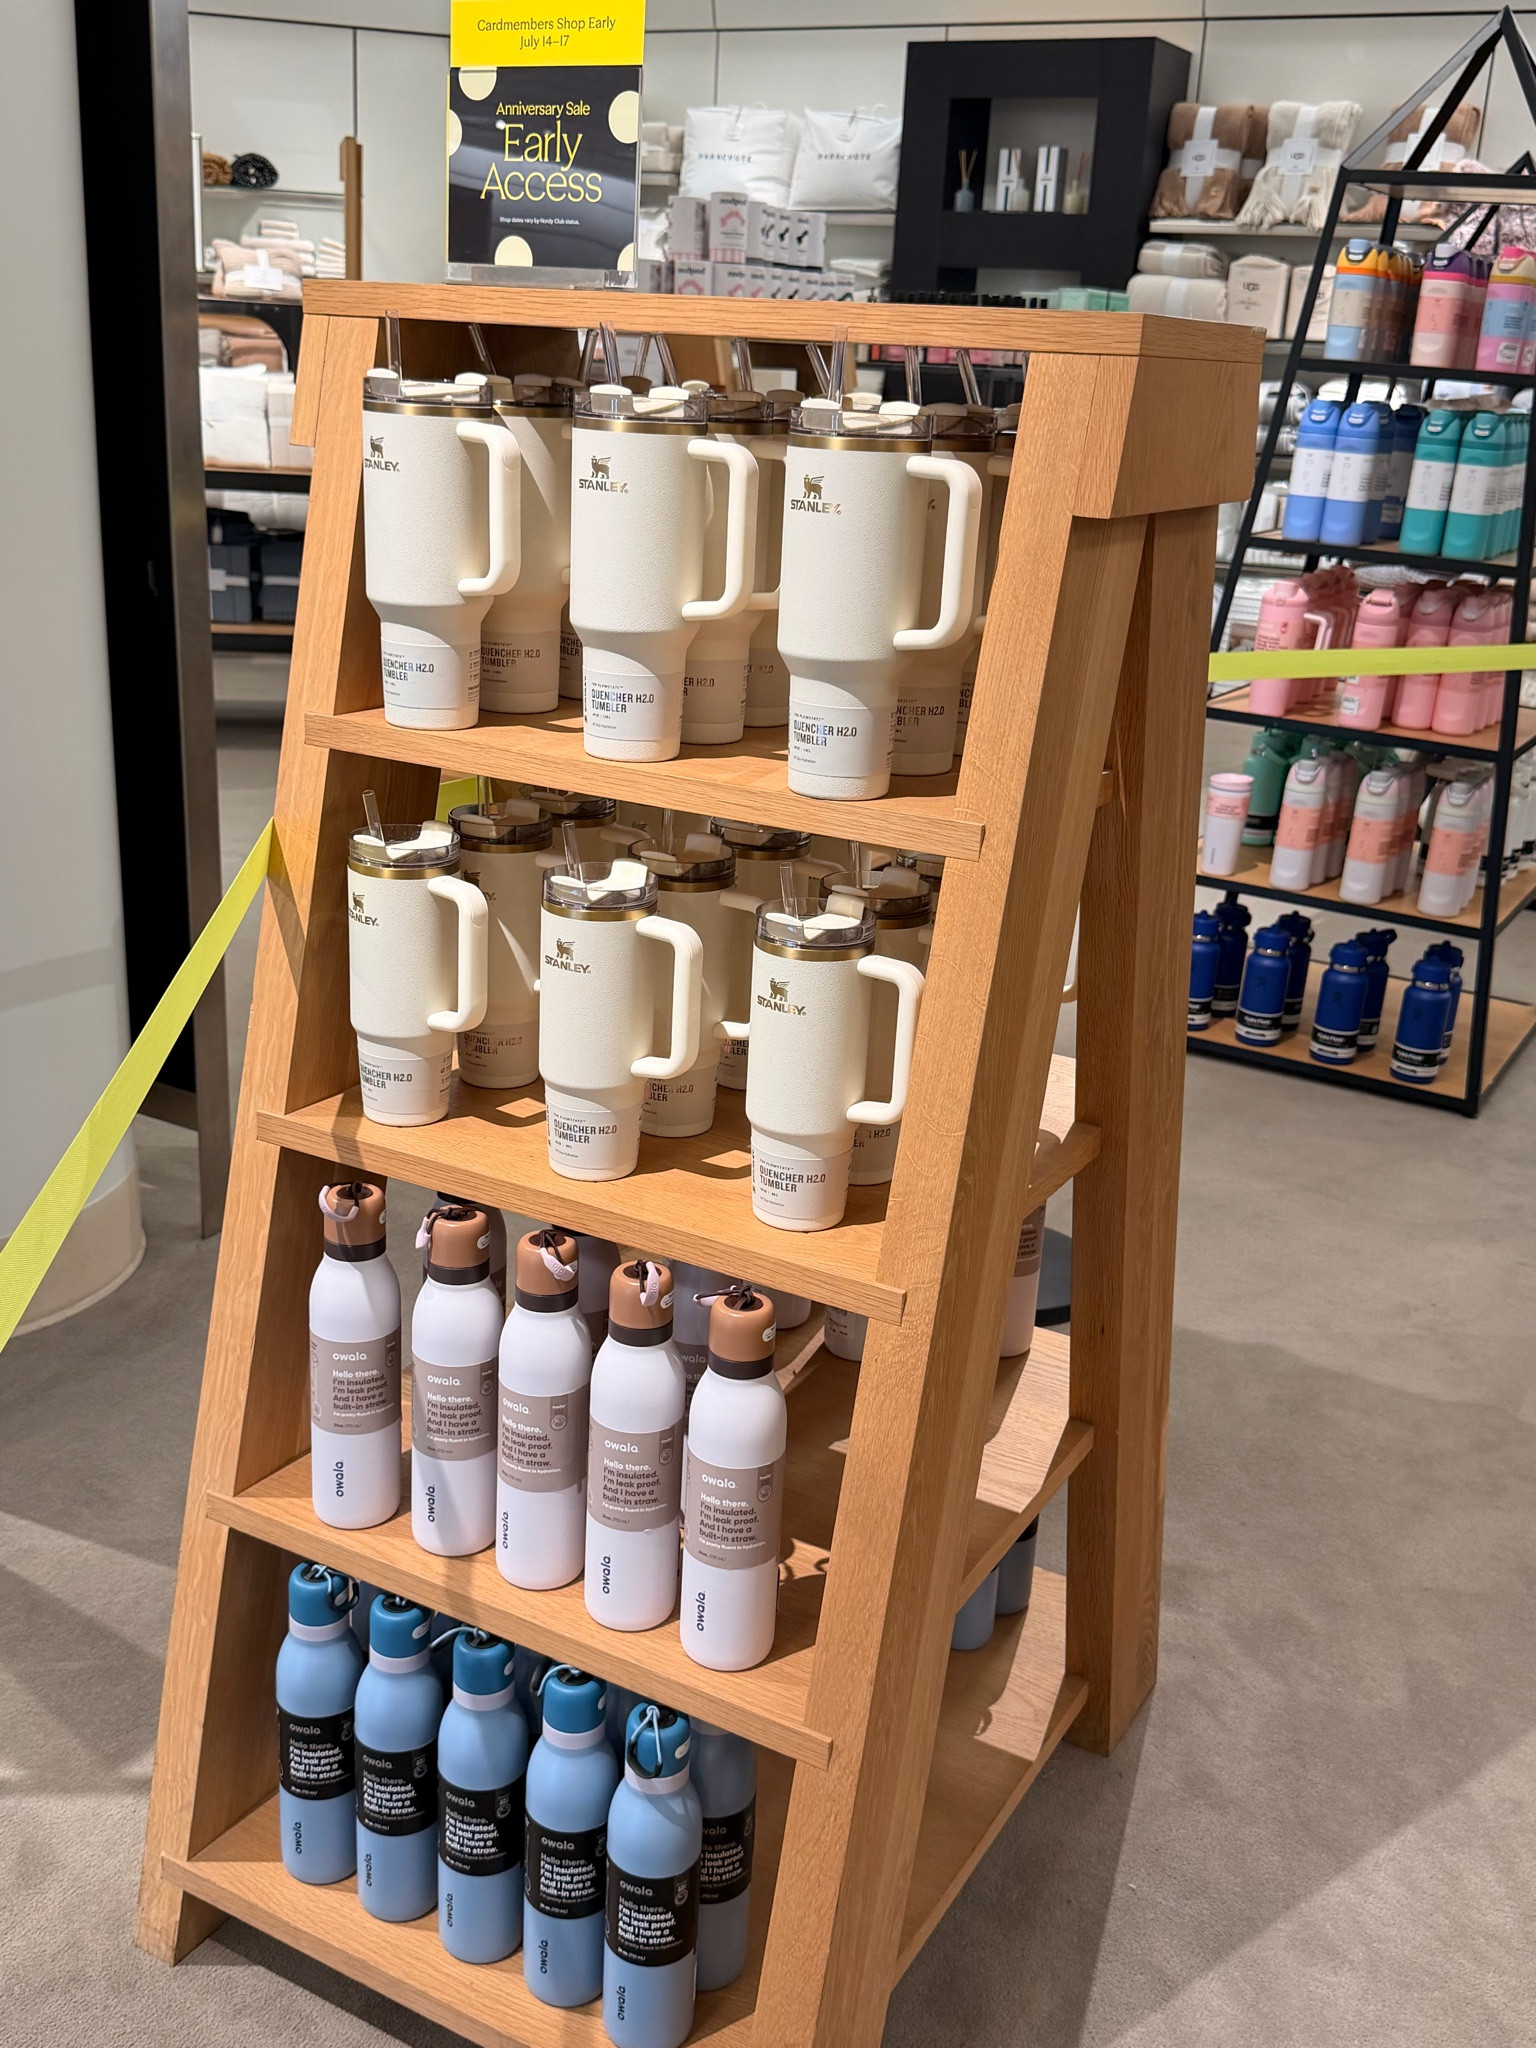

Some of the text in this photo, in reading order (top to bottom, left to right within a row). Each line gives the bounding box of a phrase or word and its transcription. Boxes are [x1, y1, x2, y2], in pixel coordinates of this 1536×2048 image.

[477, 16, 616, 32] Cardmembers Shop Early
[520, 36, 539, 50] July
[496, 100, 590, 118] Anniversary Sale
[504, 120, 583, 171] Early
[480, 162, 602, 203] Access
[578, 478, 627, 494] STANLEY
[790, 498, 838, 515] STANLEY
[415, 663, 434, 673] H2.0
[591, 688, 655, 704] QUENCHER H2.0
[592, 700, 627, 713] TUMBLER
[794, 719, 857, 737] QUENCHER H2.0
[794, 731, 827, 747] TUMBLER
[544, 954, 589, 974] STANLEY
[757, 995, 804, 1016] STANLEY
[393, 1073, 412, 1082] H2.0
[554, 1119, 617, 1135] QUENCHER H2.0
[554, 1128, 590, 1144] TUMBLER
[760, 1165, 826, 1184] QUENCHER H2.0
[760, 1175, 797, 1193] TUMBLER
[332, 1352, 367, 1360] owala
[332, 1369, 380, 1378] Hello there.
[427, 1375, 460, 1386] owala
[333, 1378, 345, 1386] I'm
[333, 1394, 350, 1402] And
[356, 1393, 376, 1402] have
[427, 1391, 446, 1402] Hello
[427, 1400, 480, 1411] I'm insulated.
[503, 1397, 529, 1414] owala
[427, 1409, 438, 1417] I'm
[459, 1409, 483, 1421] proof.
[427, 1417, 442, 1427] And
[427, 1425, 455, 1435] built-in
[502, 1414, 542, 1433] Hello there.
[511, 1429, 550, 1441] insulated.
[502, 1440, 513, 1452] And
[518, 1448, 538, 1458] have
[511, 1437, 526, 1448] leak
[528, 1442, 553, 1450] proof.
[604, 1440, 638, 1453] owala
[604, 1457, 651, 1471] Hello there.
[333, 1459, 344, 1497] owala
[604, 1467, 659, 1479] I'm insulated.
[701, 1474, 736, 1488] owala
[603, 1475, 661, 1489] I'm leak proof.
[603, 1484, 618, 1494] And
[425, 1485, 435, 1523] owala
[602, 1492, 660, 1505] built-in straw.
[700, 1492, 721, 1505] Hello
[700, 1501, 756, 1516] I'm insulated.
[700, 1510, 759, 1526] I'm leak proof.
[700, 1519, 715, 1530] And
[722, 1525, 744, 1533] have
[699, 1527, 757, 1543] built-in straw.
[601, 1555, 611, 1594] owala
[695, 1591, 706, 1632] owala
[290, 1723, 321, 1735] owala
[363, 1754, 392, 1769] owala
[445, 1790, 476, 1808] owala
[293, 1821, 302, 1854] owala
[540, 1836, 575, 1850] owala
[620, 1880, 653, 1896] owala
[619, 1895, 666, 1913] Hello there.
[631, 1909, 674, 1920] insulated.
[618, 1920, 633, 1933] And
[639, 1928, 661, 1936] have
[631, 1918, 649, 1928] leak
[651, 1918, 676, 1929] proof.
[618, 1927, 647, 1944] built-in
[648, 1935, 675, 1945] straw.
[538, 1939, 549, 1974] owala
[617, 1985, 626, 2021] owala
